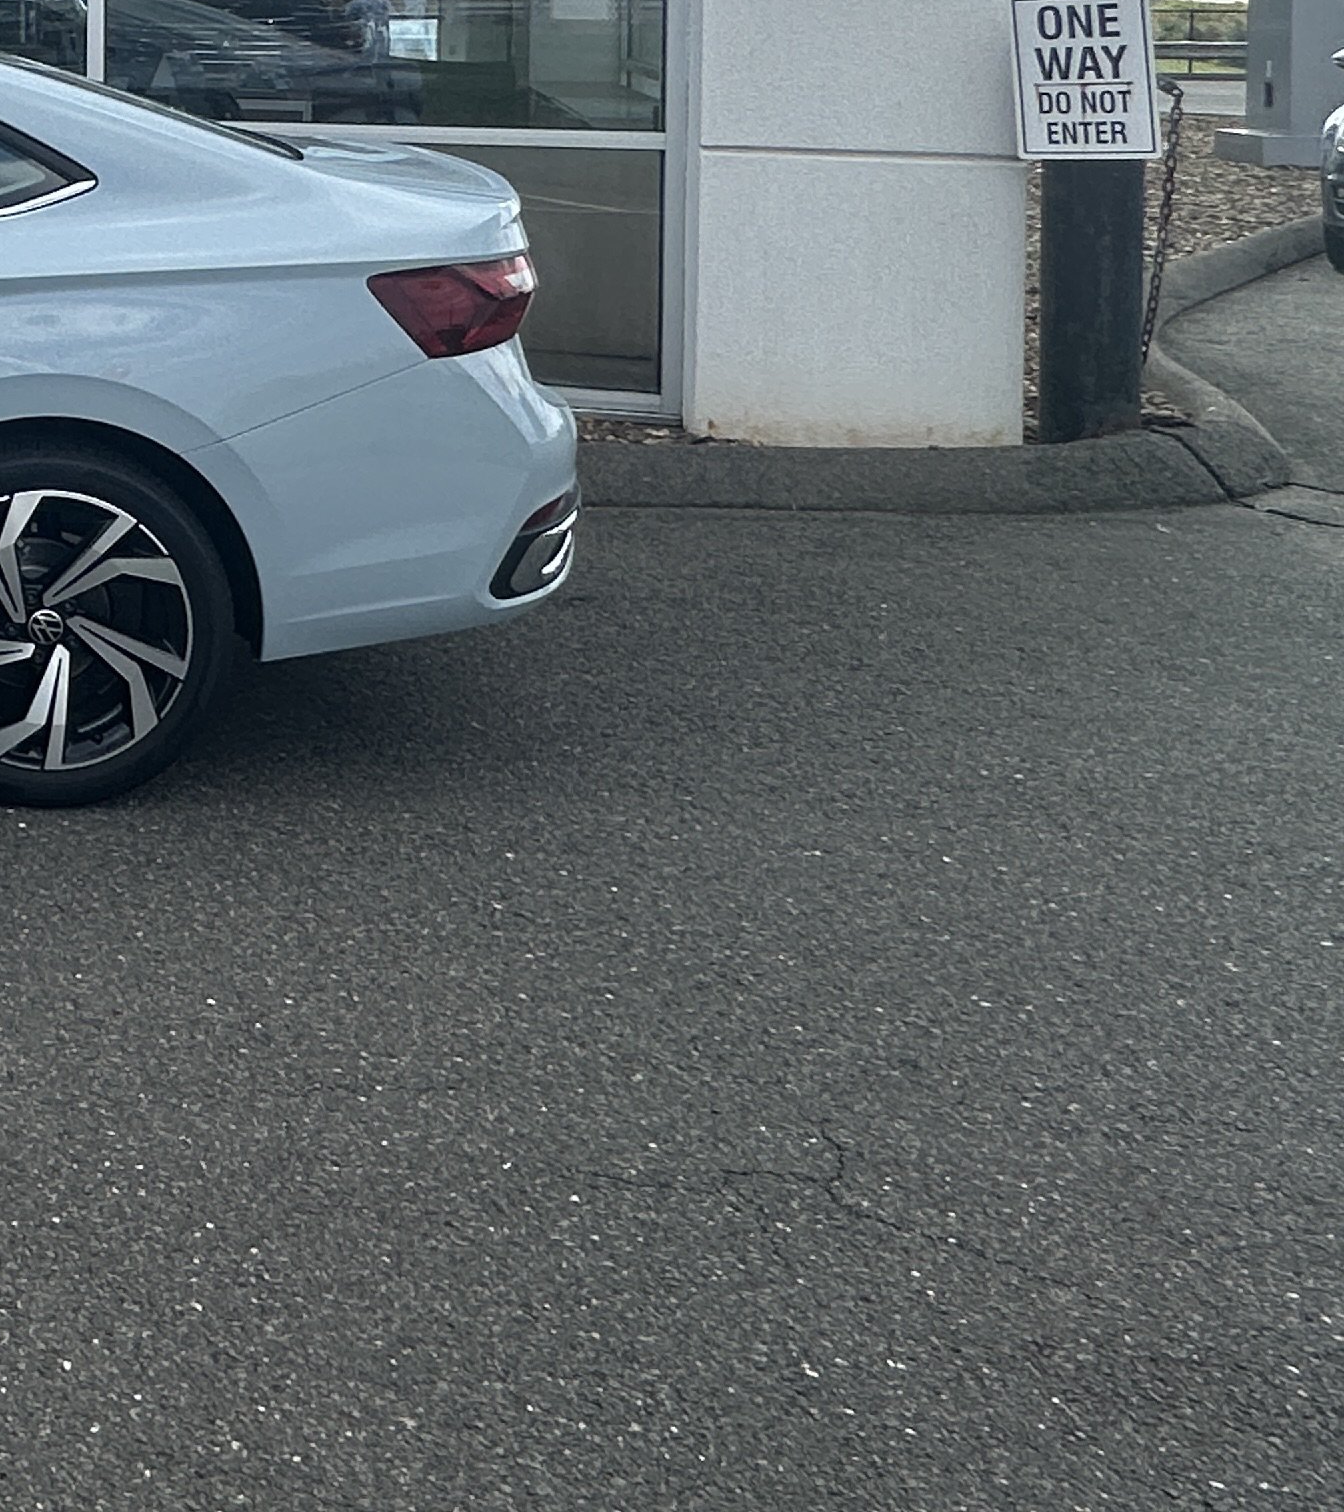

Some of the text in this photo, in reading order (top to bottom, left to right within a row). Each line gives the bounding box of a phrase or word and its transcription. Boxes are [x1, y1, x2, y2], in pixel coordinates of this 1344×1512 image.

[1036, 3, 1121, 39] ONE
[1034, 45, 1128, 81] WAY
[1038, 89, 1132, 114] DO NOT
[1046, 120, 1129, 145] ENTER
